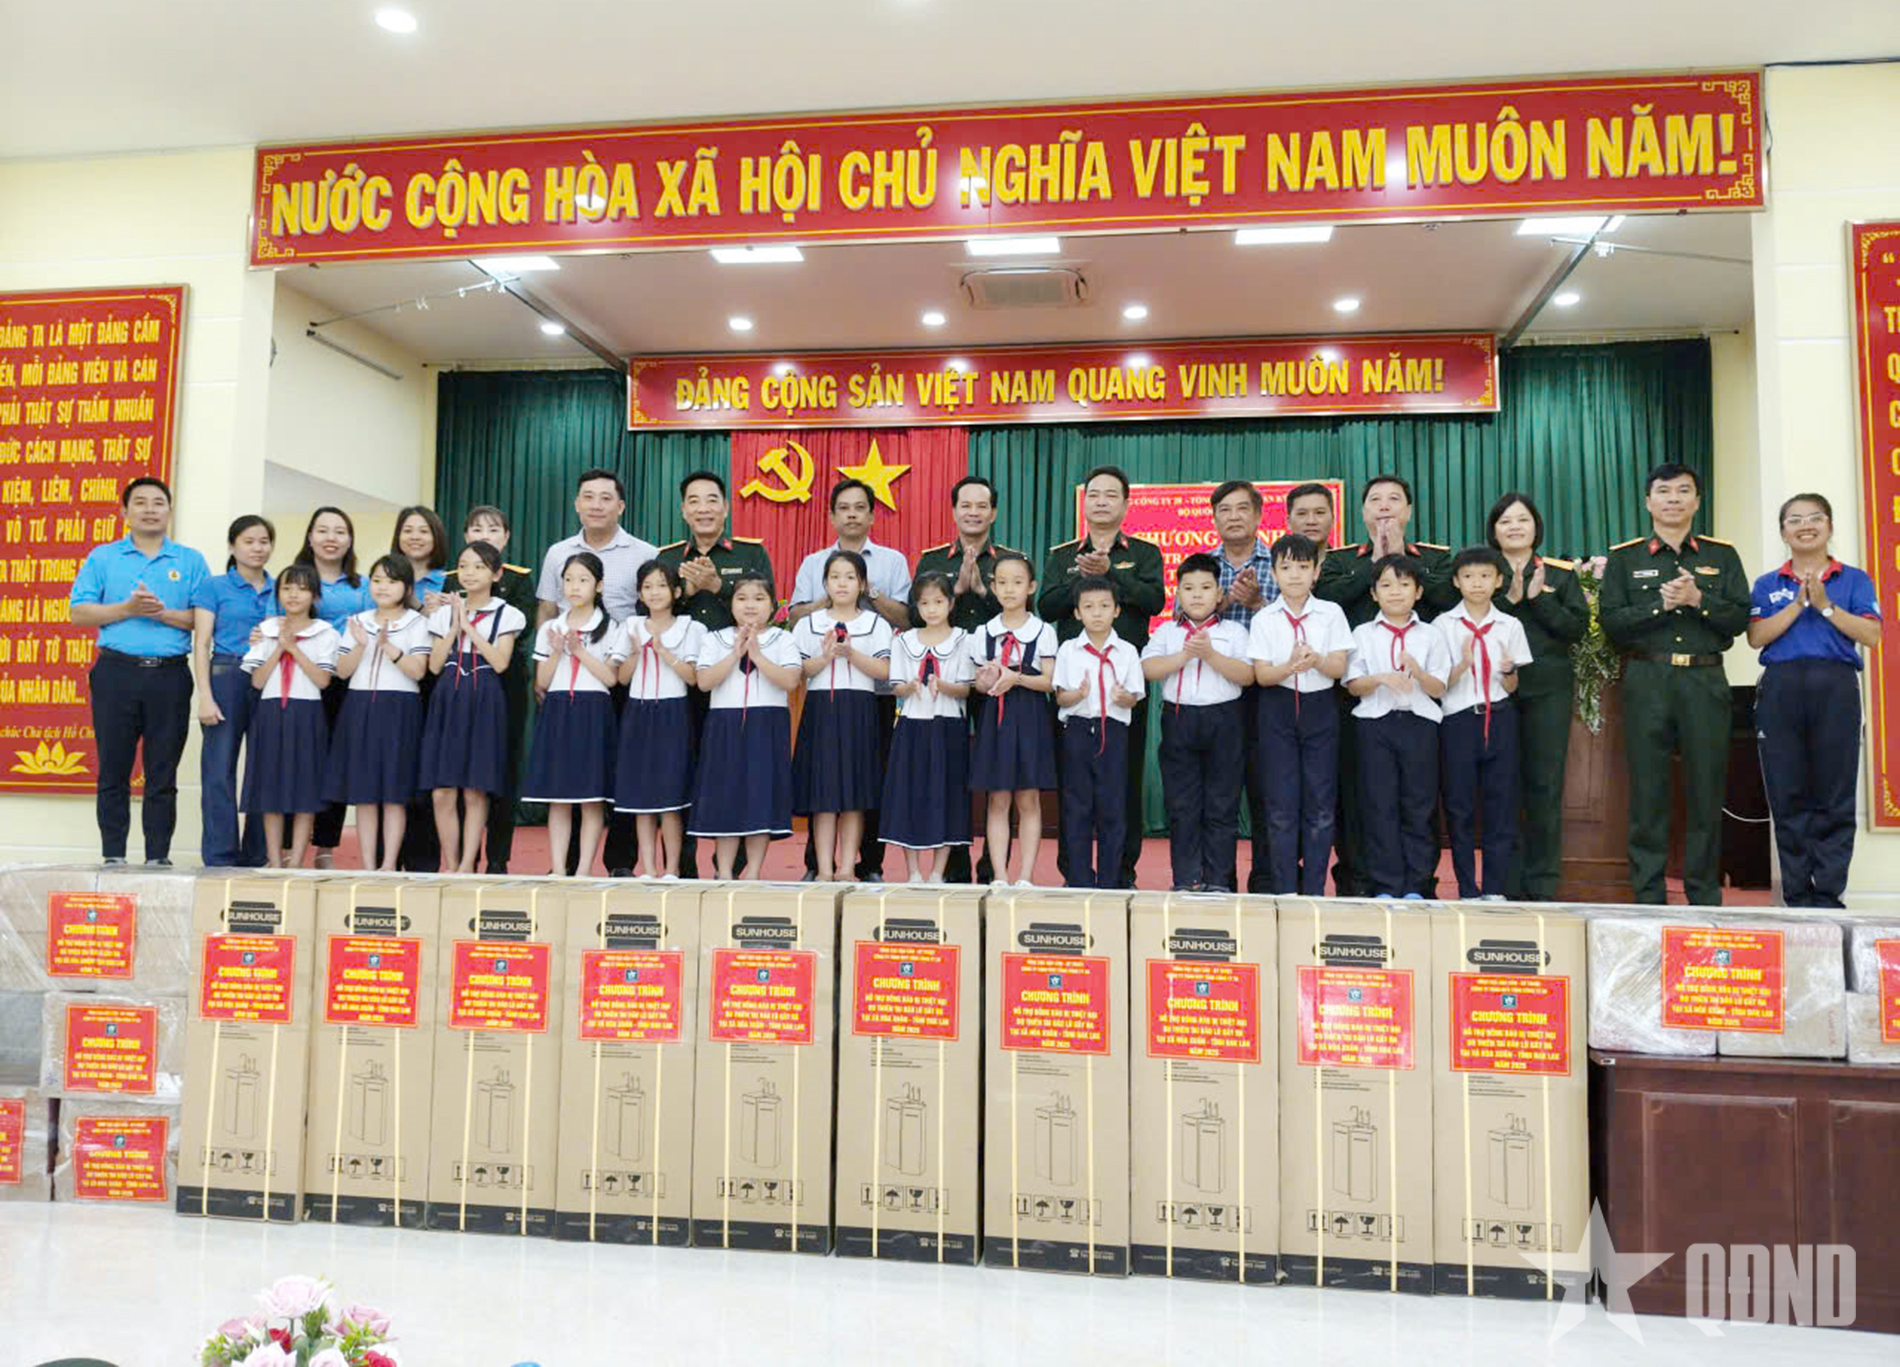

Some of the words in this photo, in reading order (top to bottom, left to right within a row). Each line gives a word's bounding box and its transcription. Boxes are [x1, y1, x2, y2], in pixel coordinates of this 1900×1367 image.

[271, 164, 393, 237] NƯỚC
[406, 158, 530, 238] CỘNG
[544, 150, 639, 223] HÒA
[655, 147, 720, 217] XÃ
[740, 140, 821, 222] HỘI
[838, 126, 936, 210] CHỦ
[960, 130, 1112, 209] NGHĨA
[1129, 123, 1246, 205] VIỆT
[1268, 129, 1386, 191] NAM
[1406, 107, 1567, 185] MUÔN
[1587, 104, 1736, 177] NĂM!
[33, 325, 44, 347] TA
[50, 318, 63, 346] LÀ
[68, 317, 94, 350] MỘT
[97, 313, 129, 344] ĐẢNG
[47, 355, 78, 386] ĐẢNG
[83, 355, 109, 384] VIÊN
[114, 355, 128, 382] VÀ
[132, 354, 157, 382] CÁN
[676, 367, 749, 411] ĐẢNG
[761, 369, 837, 416] CỘNG
[848, 362, 904, 408] SẢN
[916, 368, 980, 412] VIỆT
[991, 368, 1055, 405] NAM
[1067, 363, 1166, 408] QUANG
[1179, 363, 1247, 398] VINH
[1260, 355, 1349, 396] MUÔN
[1362, 352, 1444, 395] NĂM!
[25, 396, 53, 429] THẬT
[57, 398, 73, 428] SỰ
[25, 435, 55, 463] CÁCH
[102, 434, 131, 466] THẬT
[135, 435, 153, 466] SỰ
[6, 514, 22, 543] VÔ
[56, 511, 86, 542] PHẢI
[10, 554, 37, 588] THẬT
[26, 594, 39, 622] LÀ
[66, 633, 95, 667] THẬT
[18, 674, 50, 703] NHÂN
[736, 927, 796, 938] SUNHOUSE
[1169, 940, 1236, 952] SUNHOUSE
[1320, 946, 1388, 958] SUNHOUSE
